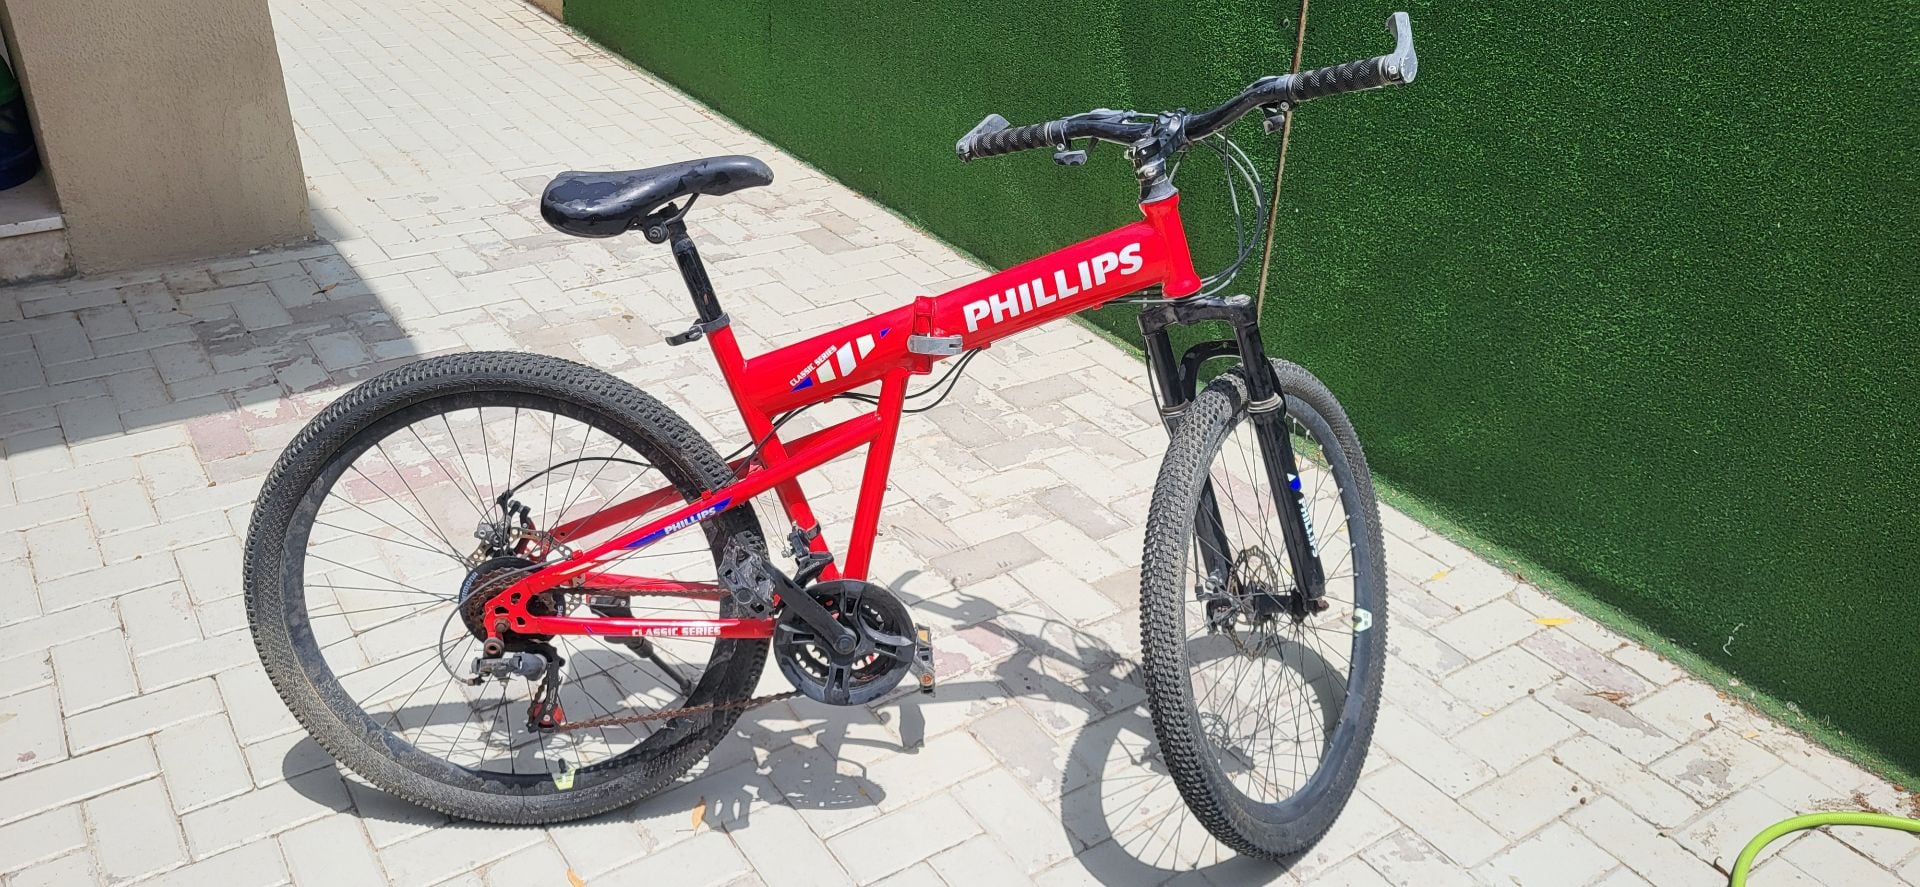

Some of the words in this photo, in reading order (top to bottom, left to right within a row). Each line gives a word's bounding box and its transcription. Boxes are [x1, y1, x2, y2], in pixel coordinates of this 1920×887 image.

[963, 243, 1143, 332] PHILLIPS
[789, 363, 816, 387] CLASSIC
[814, 344, 837, 366] SERIES
[664, 507, 716, 535] PHILLIPS
[1298, 498, 1318, 557] PHILLIPS
[632, 628, 678, 637] CLASSIC
[681, 626, 721, 636] SERIES
